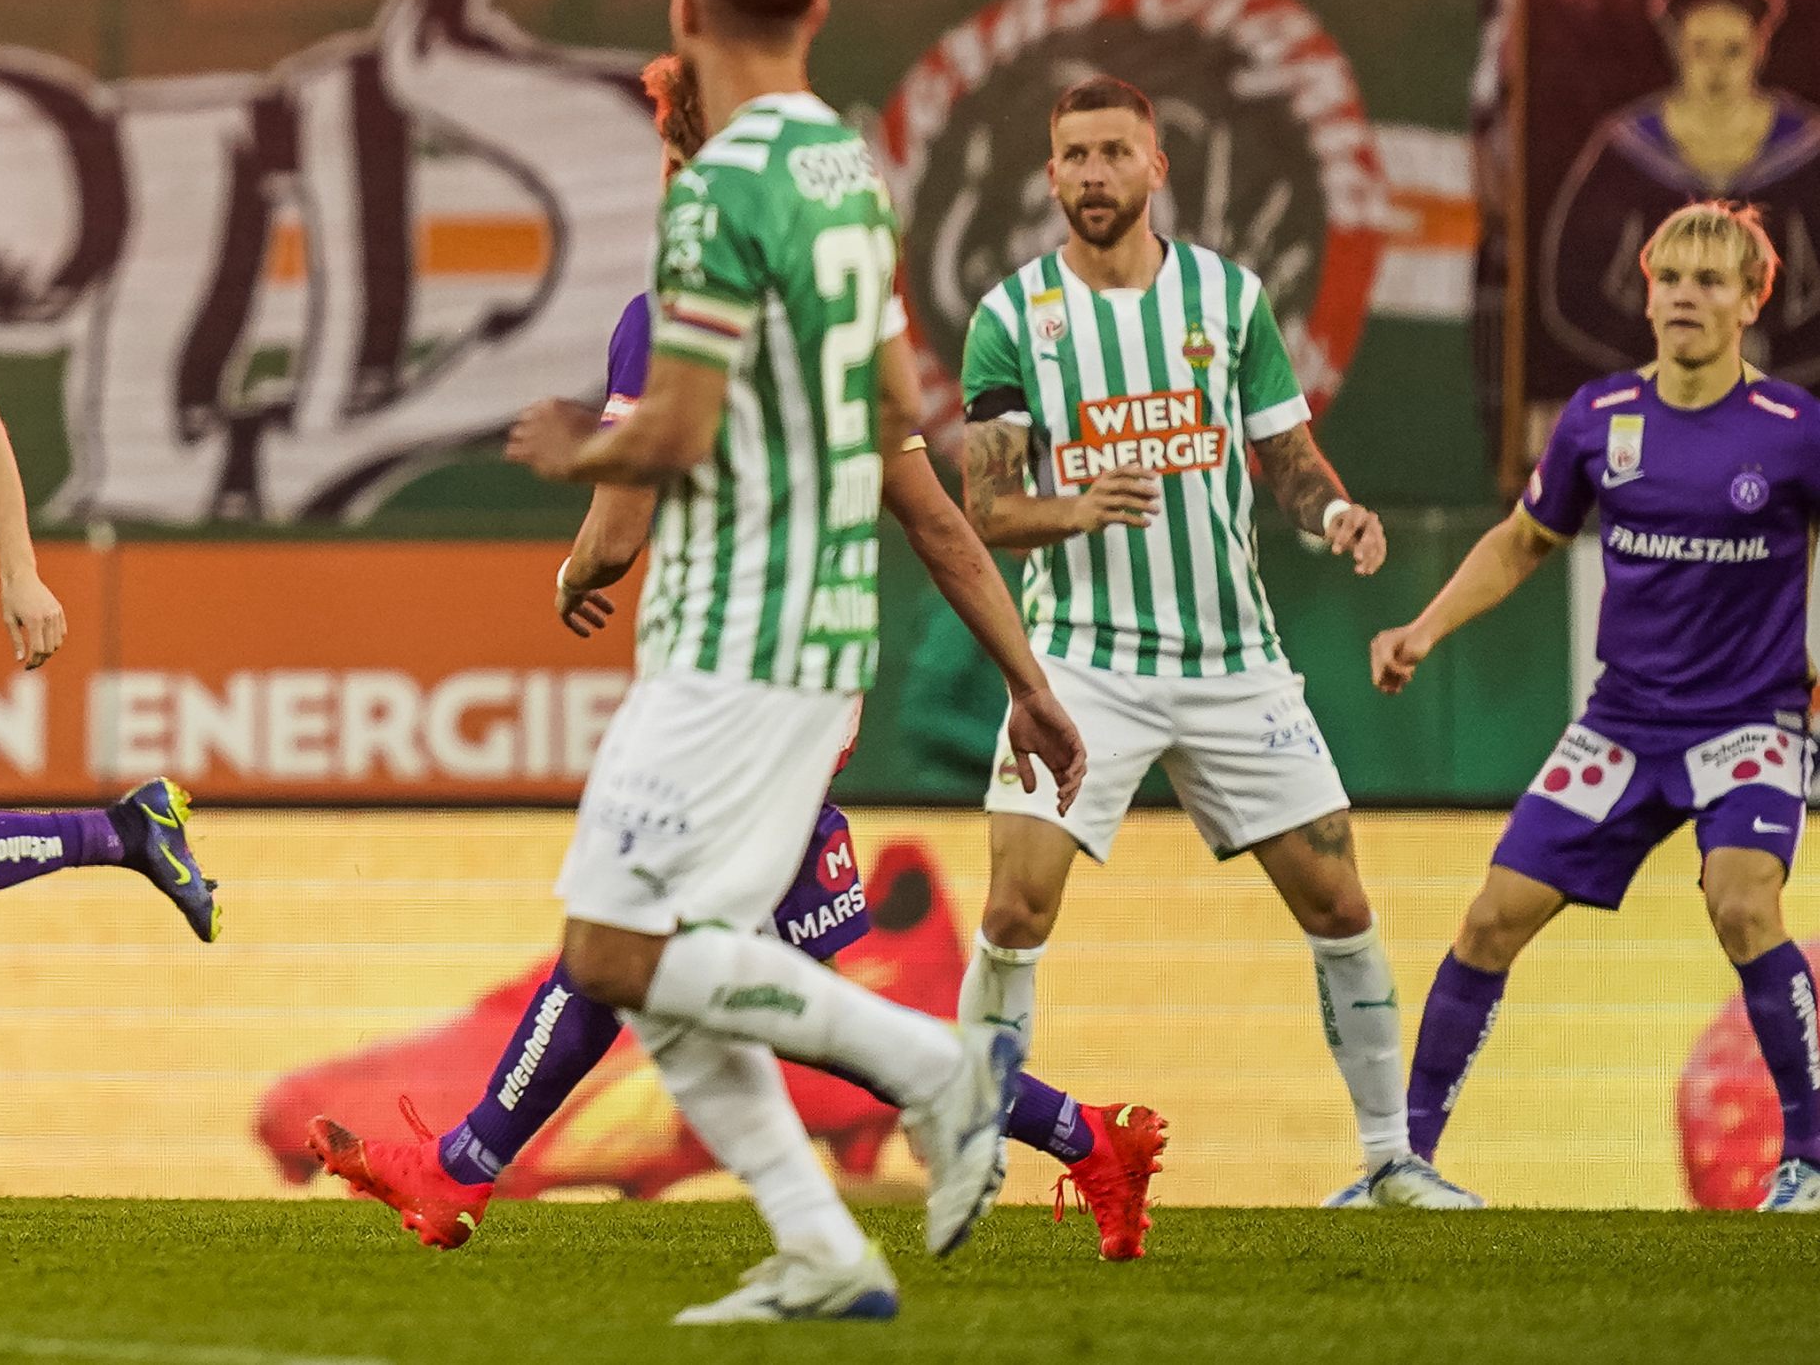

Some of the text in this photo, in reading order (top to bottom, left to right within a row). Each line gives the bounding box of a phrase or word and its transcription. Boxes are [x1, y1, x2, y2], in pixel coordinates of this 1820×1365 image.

[1086, 394, 1196, 436] WIEN
[1061, 431, 1221, 480] ENERGIE
[1608, 525, 1770, 563] FRANKSTAHL
[787, 882, 867, 946] MARS
